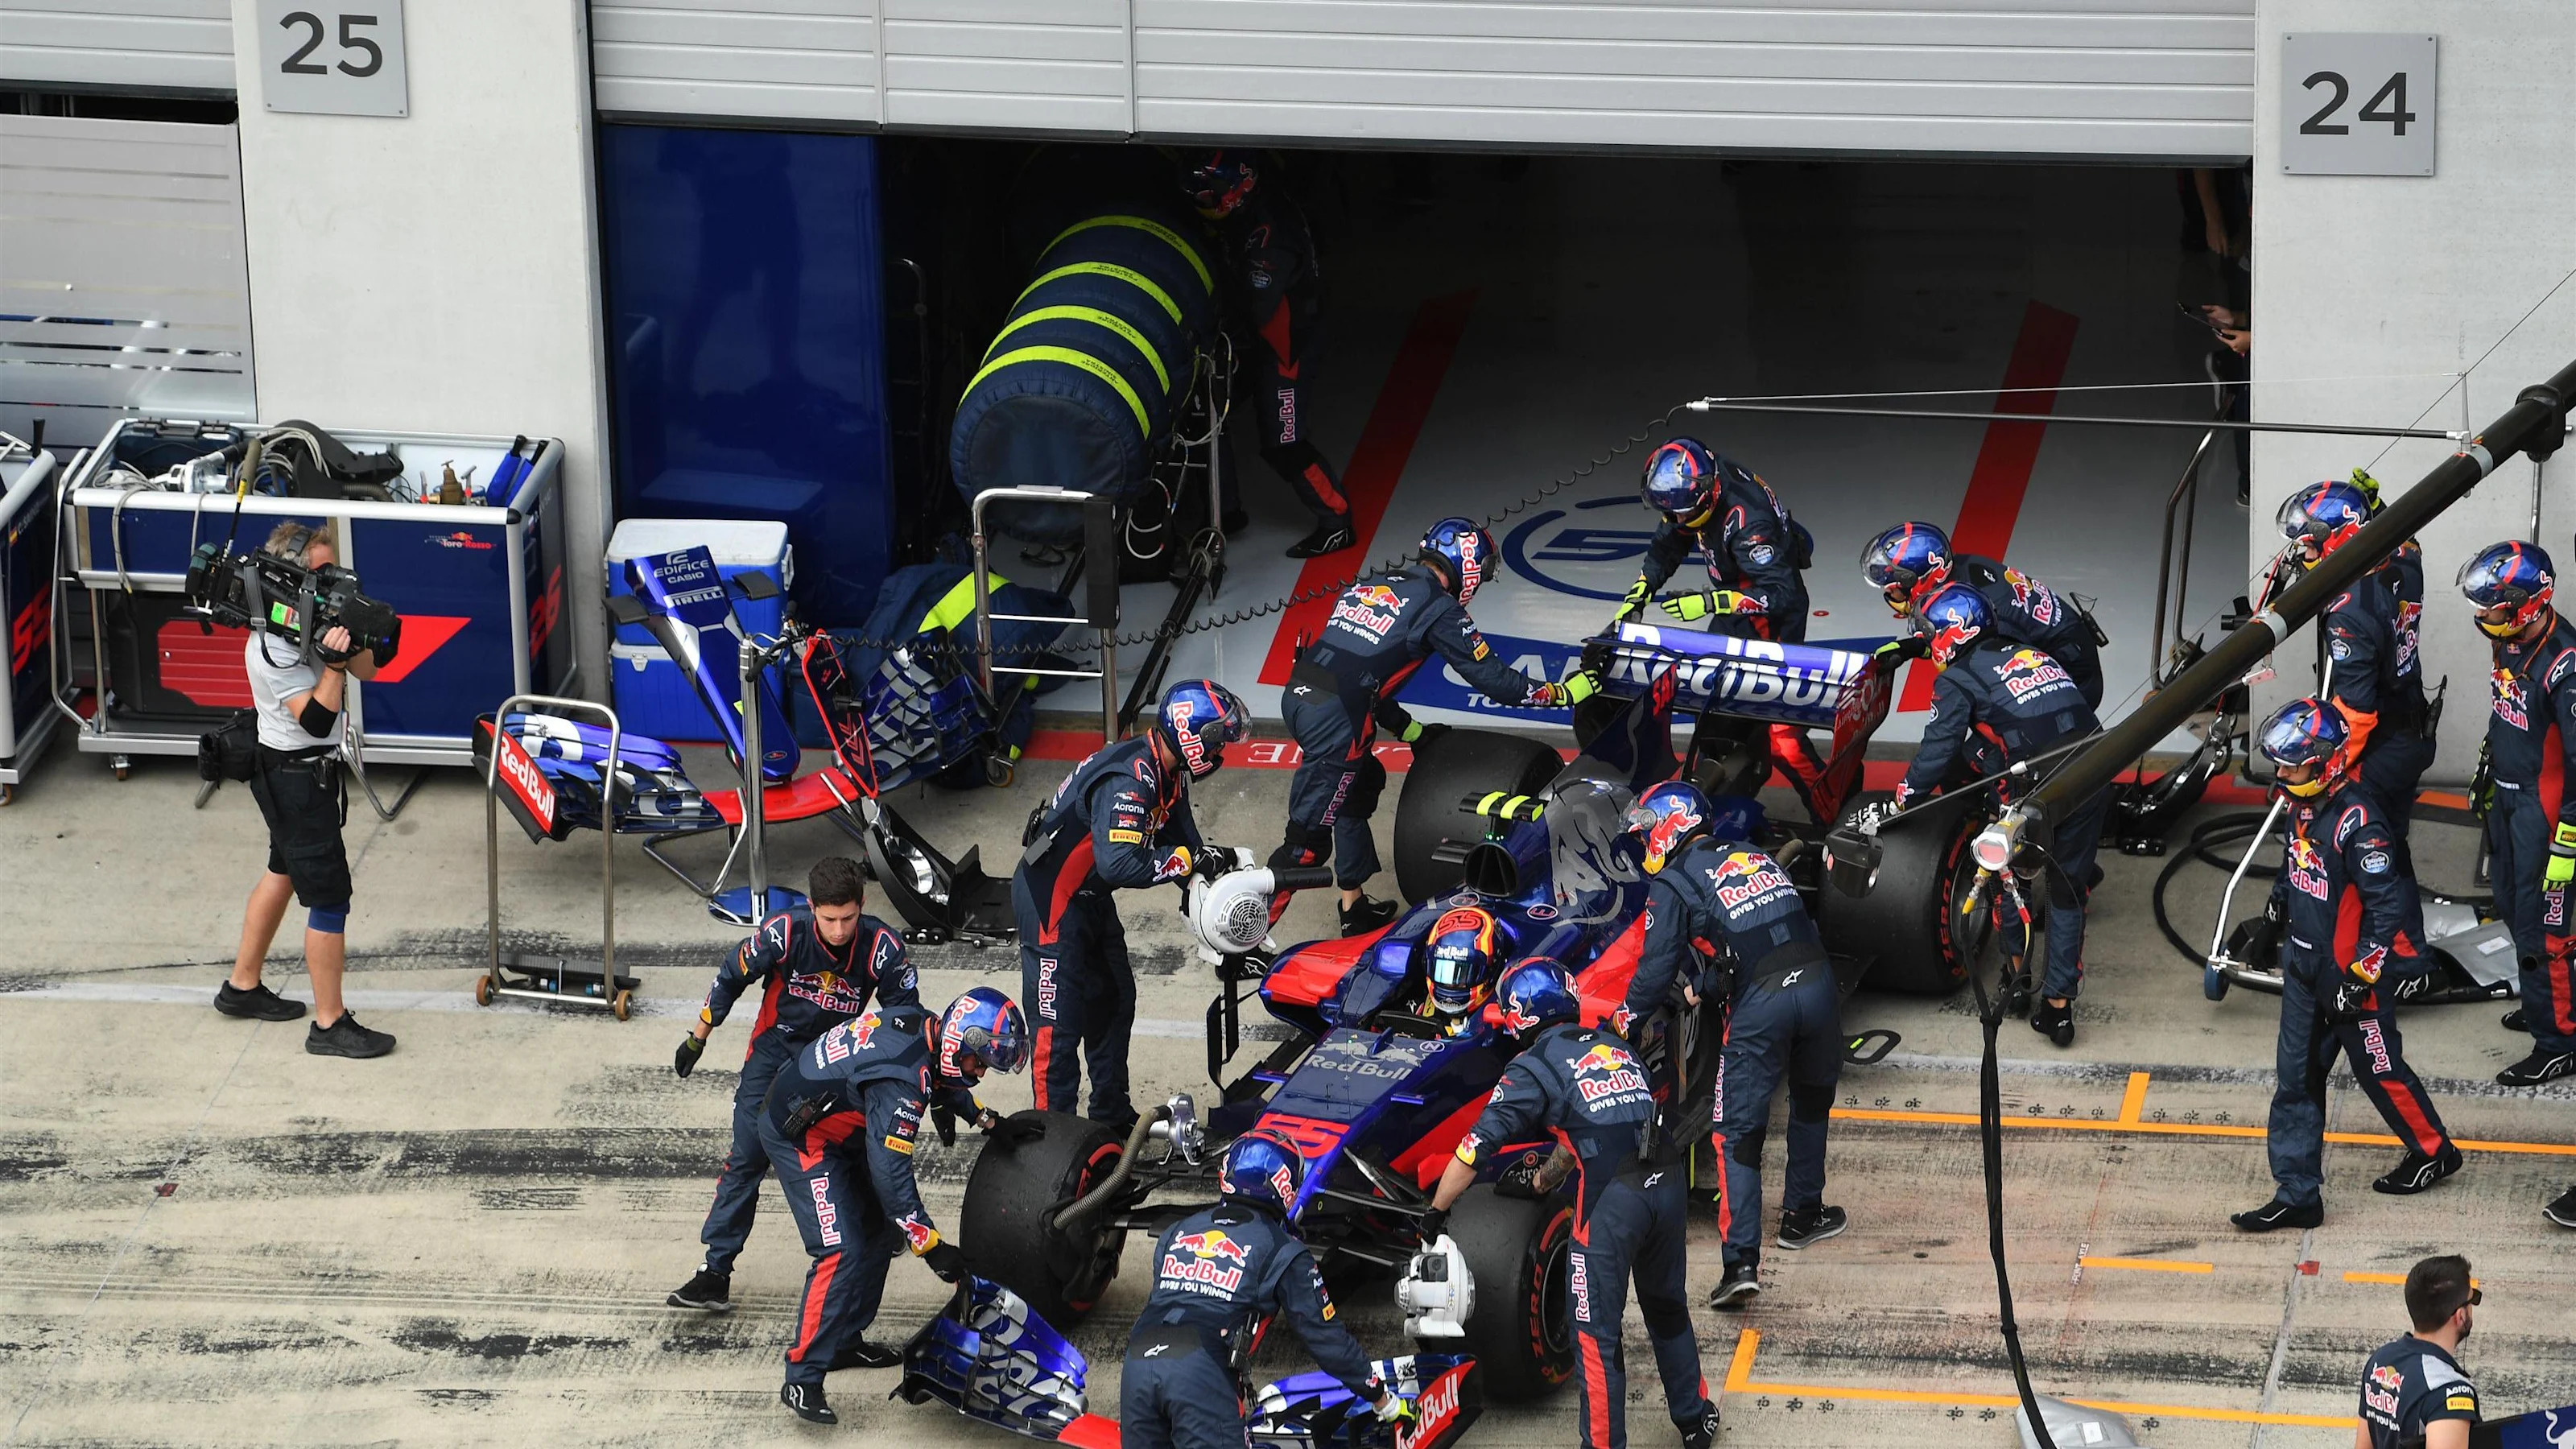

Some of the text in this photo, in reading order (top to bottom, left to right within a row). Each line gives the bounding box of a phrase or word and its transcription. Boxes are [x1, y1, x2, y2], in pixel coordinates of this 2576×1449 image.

[279, 11, 383, 78] 25
[2300, 71, 2416, 136] 24
[654, 560, 709, 578] EDIFICE
[667, 572, 704, 584] CASIO
[12, 581, 51, 676] 55
[530, 565, 562, 662] 26
[1730, 902, 1755, 919] GIVES
[1755, 893, 1773, 907] YOU
[1941, 877, 1955, 963] ZERO
[1589, 1098, 1616, 1113] GIVES
[1618, 1094, 1635, 1106] YOU
[1179, 1282, 1199, 1291] YOU
[1199, 1283, 1233, 1302] WINGS
[1530, 1263, 1543, 1359] ZERO
